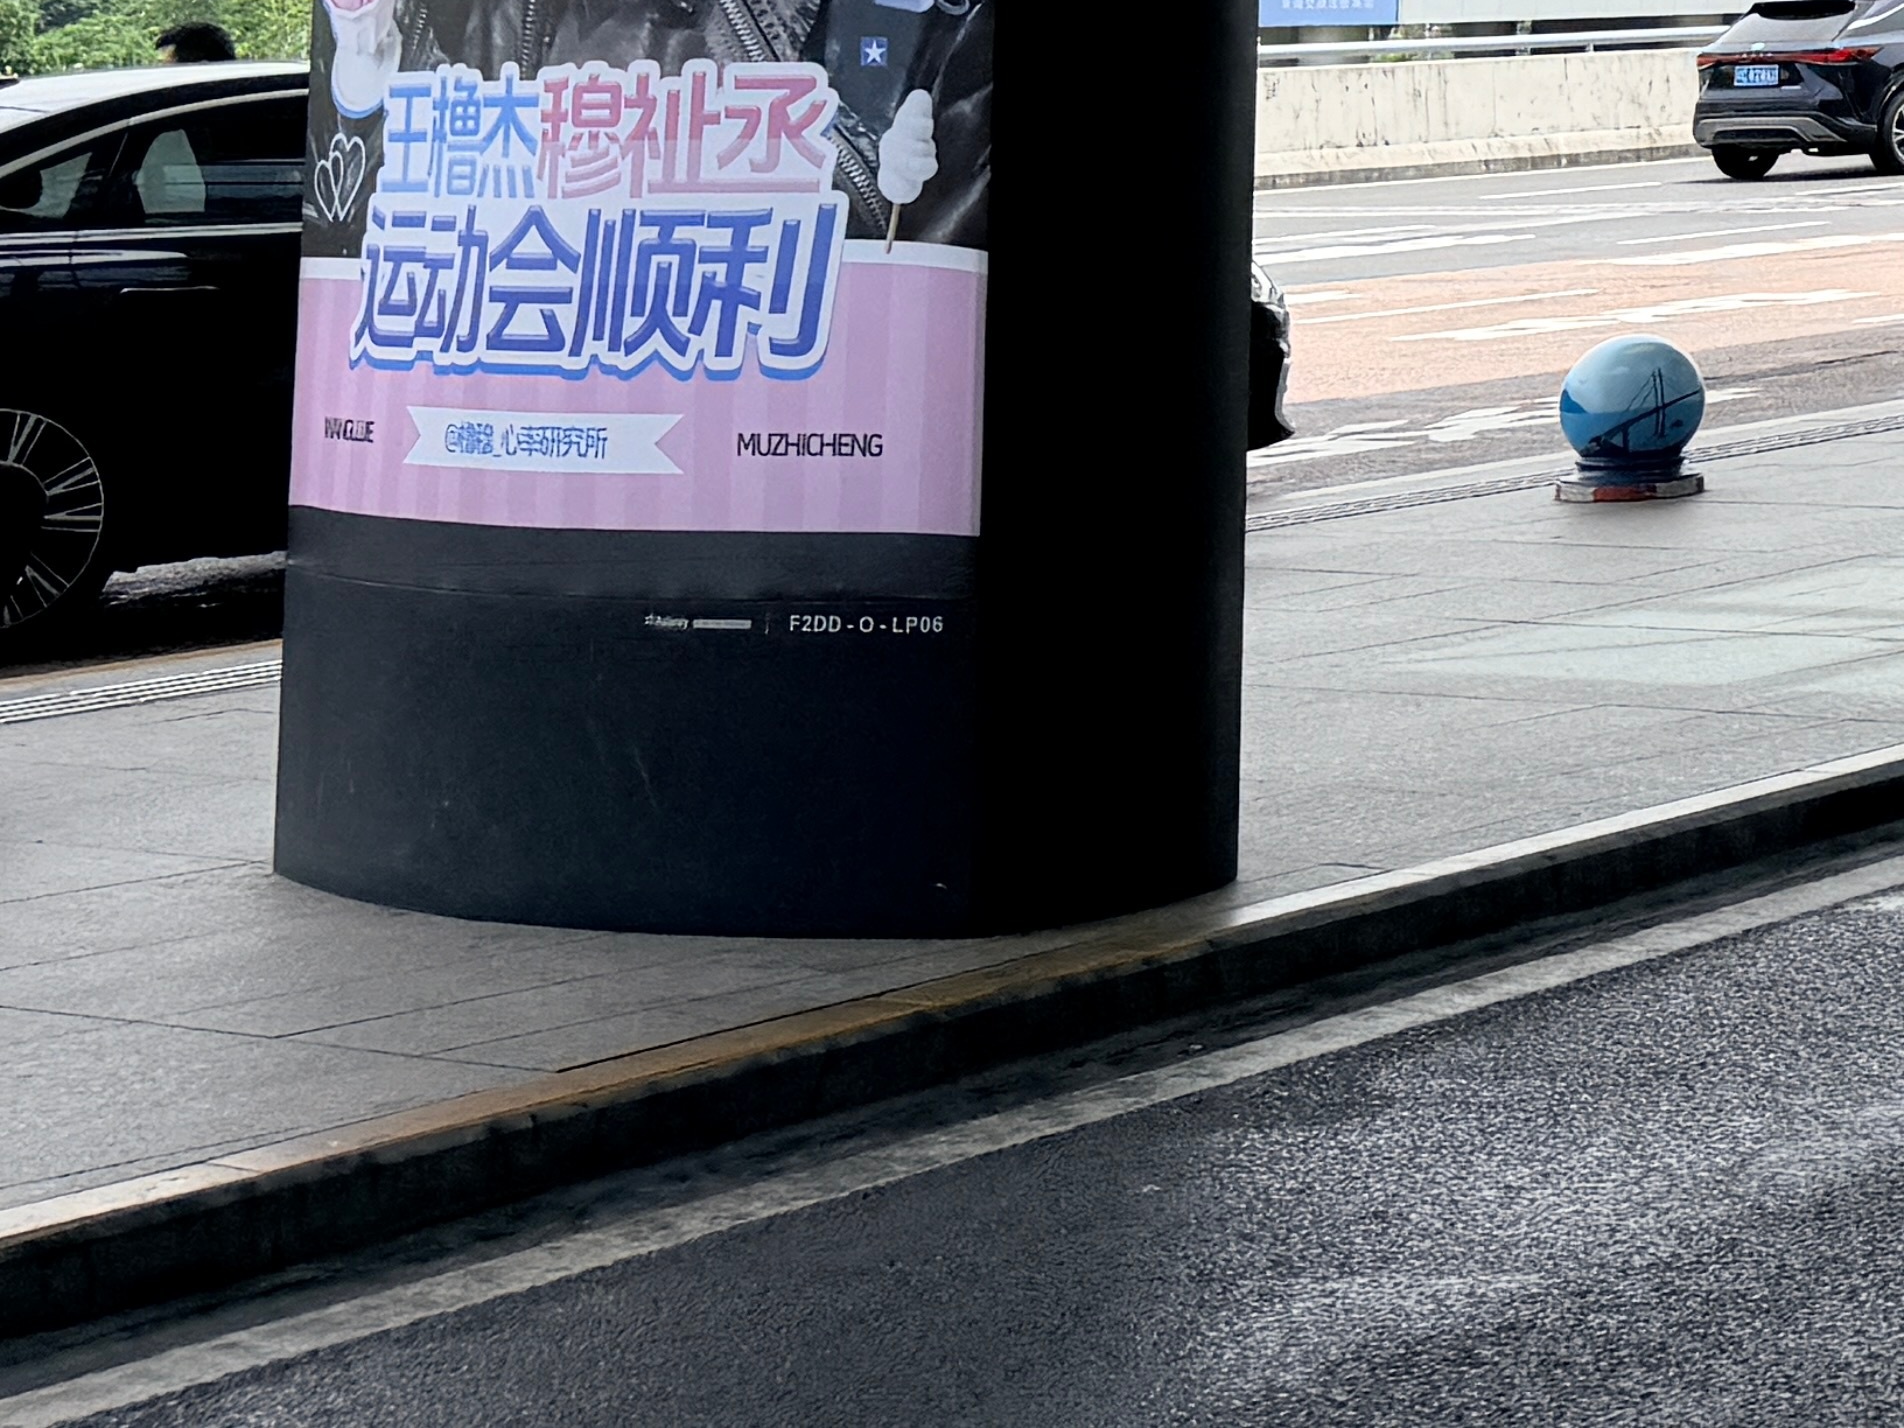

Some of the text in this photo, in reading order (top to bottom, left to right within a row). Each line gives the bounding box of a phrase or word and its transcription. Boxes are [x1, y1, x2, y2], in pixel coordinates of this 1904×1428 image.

[381, 71, 827, 199] 王橹杰穆祉丞
[355, 203, 838, 358] 运动会顺利
[737, 432, 883, 458] MUZHICHENG
